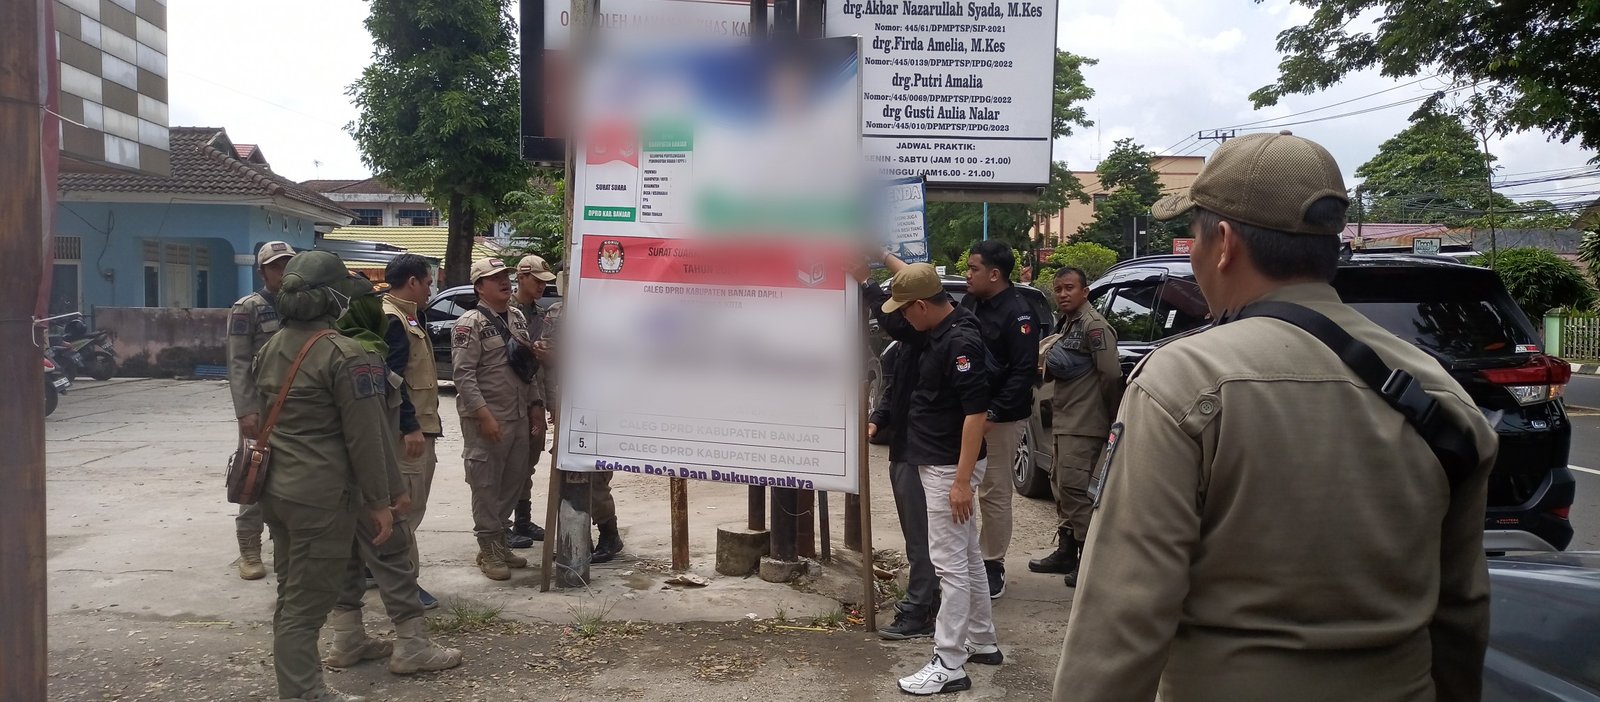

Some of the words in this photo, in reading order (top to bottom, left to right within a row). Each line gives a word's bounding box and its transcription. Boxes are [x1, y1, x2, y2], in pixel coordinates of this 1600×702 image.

[843, 0, 899, 18] drg.Akbar
[902, 1, 963, 17] Nazarullah
[968, 2, 1004, 21] Syada,
[1007, 2, 1043, 17] M.Kes
[874, 23, 903, 31] Nomor:
[904, 24, 1006, 33] 445/61/DPMPTSP/SIP-2021
[872, 36, 924, 53] drg.Firda
[927, 37, 967, 54] Amelia,
[970, 38, 1005, 53] M.Kes
[892, 72, 943, 90] drg.Putri
[945, 74, 983, 89] Amalia
[882, 104, 902, 121] drg
[904, 105, 935, 120] Gusti
[937, 106, 966, 120] Aulia
[969, 107, 1000, 121] Nalar
[896, 142, 932, 150] JADWAL
[934, 143, 976, 151] PRAKTIK:
[898, 155, 928, 163] SABTU
[930, 155, 951, 164] (JAM
[985, 157, 1011, 165] 21.00)
[968, 170, 995, 179] 21.00)
[595, 183, 611, 191] SURAT
[648, 246, 672, 257] SURAT
[643, 285, 664, 294] CALEG
[665, 286, 685, 295] DPRD
[685, 287, 726, 297] KABUPATEN
[727, 289, 756, 298] BANJAR
[579, 415, 587, 427] 4.
[661, 423, 694, 434] DPRD
[696, 425, 767, 440] KABUPATEN
[770, 430, 820, 444] BANJAR
[578, 437, 587, 449] 5.
[619, 441, 658, 454] CALEG
[661, 445, 694, 457] DPRD
[697, 448, 767, 463] KABUPATEN
[770, 454, 820, 467] BANJAR
[680, 467, 708, 480] Dan
[711, 470, 814, 490] DukunganNya
